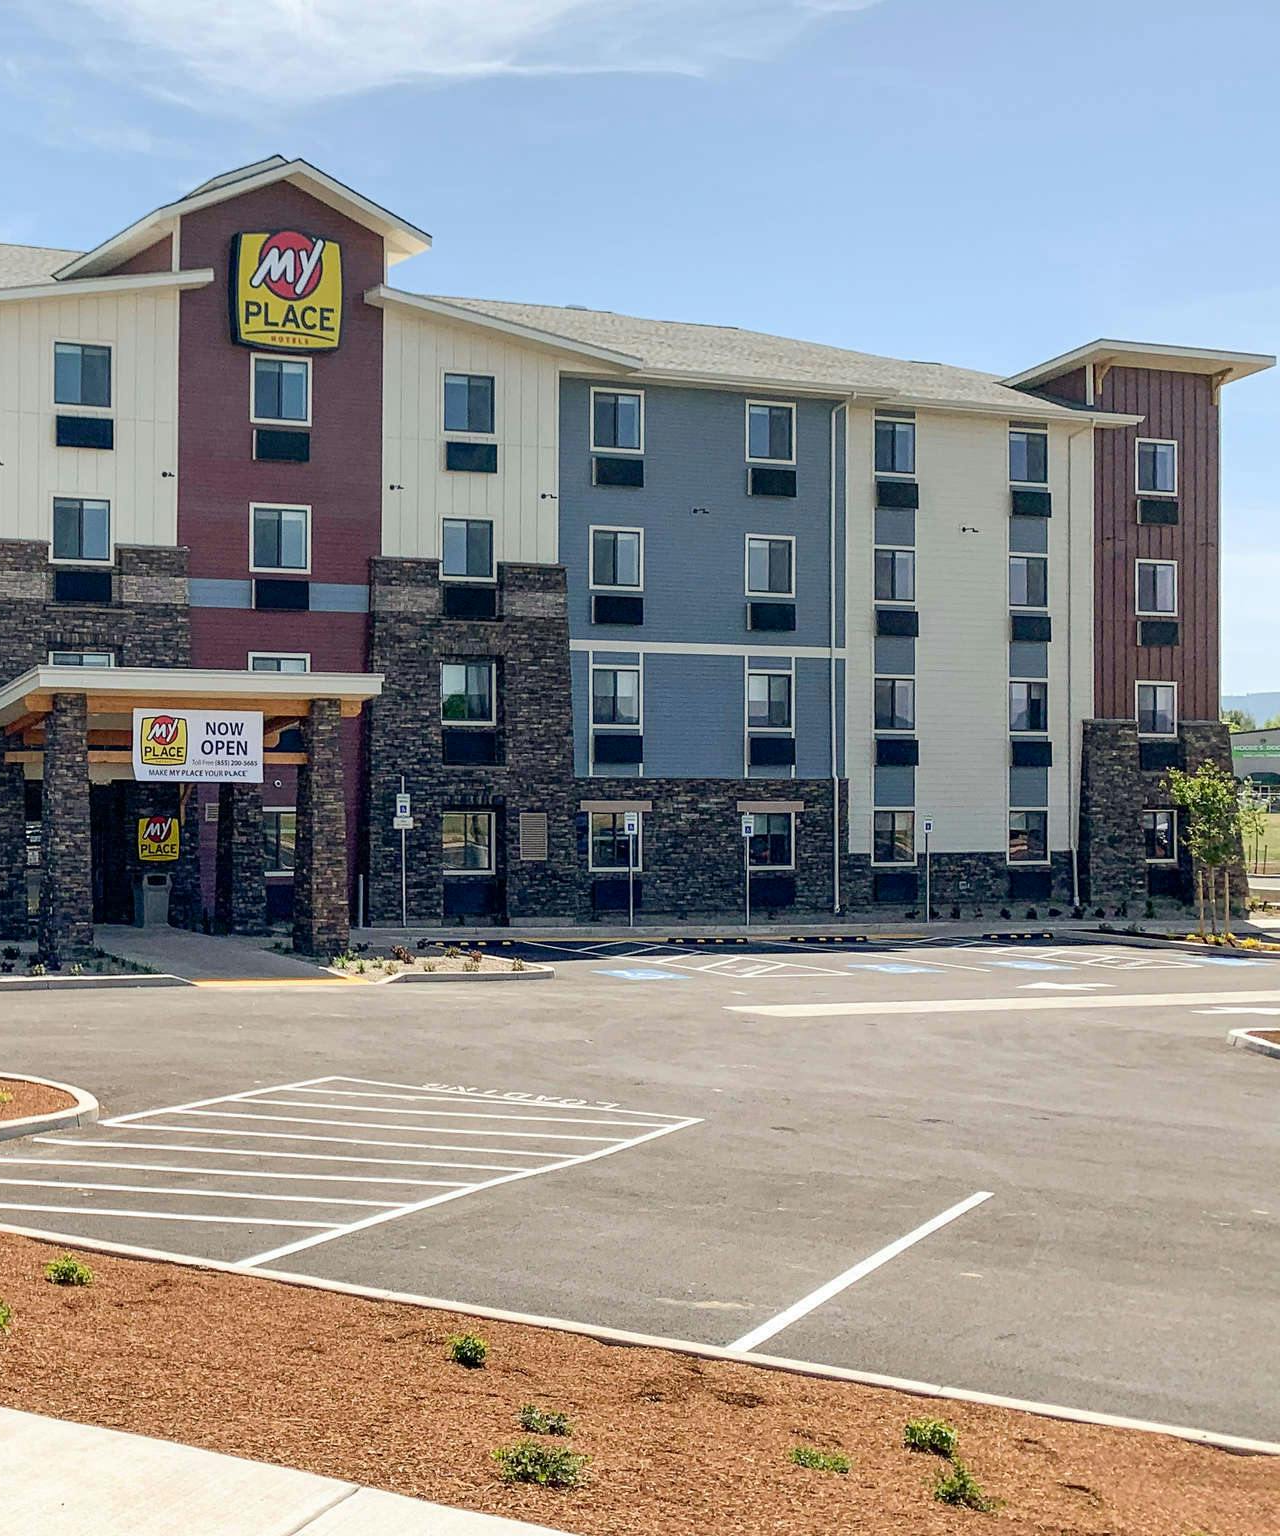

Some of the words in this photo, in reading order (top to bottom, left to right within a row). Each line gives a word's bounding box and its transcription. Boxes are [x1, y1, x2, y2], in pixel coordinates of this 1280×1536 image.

[244, 301, 335, 331] PLACE
[271, 335, 309, 345] HOTELS
[205, 721, 244, 736] NOW
[144, 746, 184, 757] PLACE
[201, 740, 248, 756] OPEN
[182, 769, 203, 777] PLACE
[205, 769, 224, 777] YOUR
[141, 844, 177, 854] PLACE
